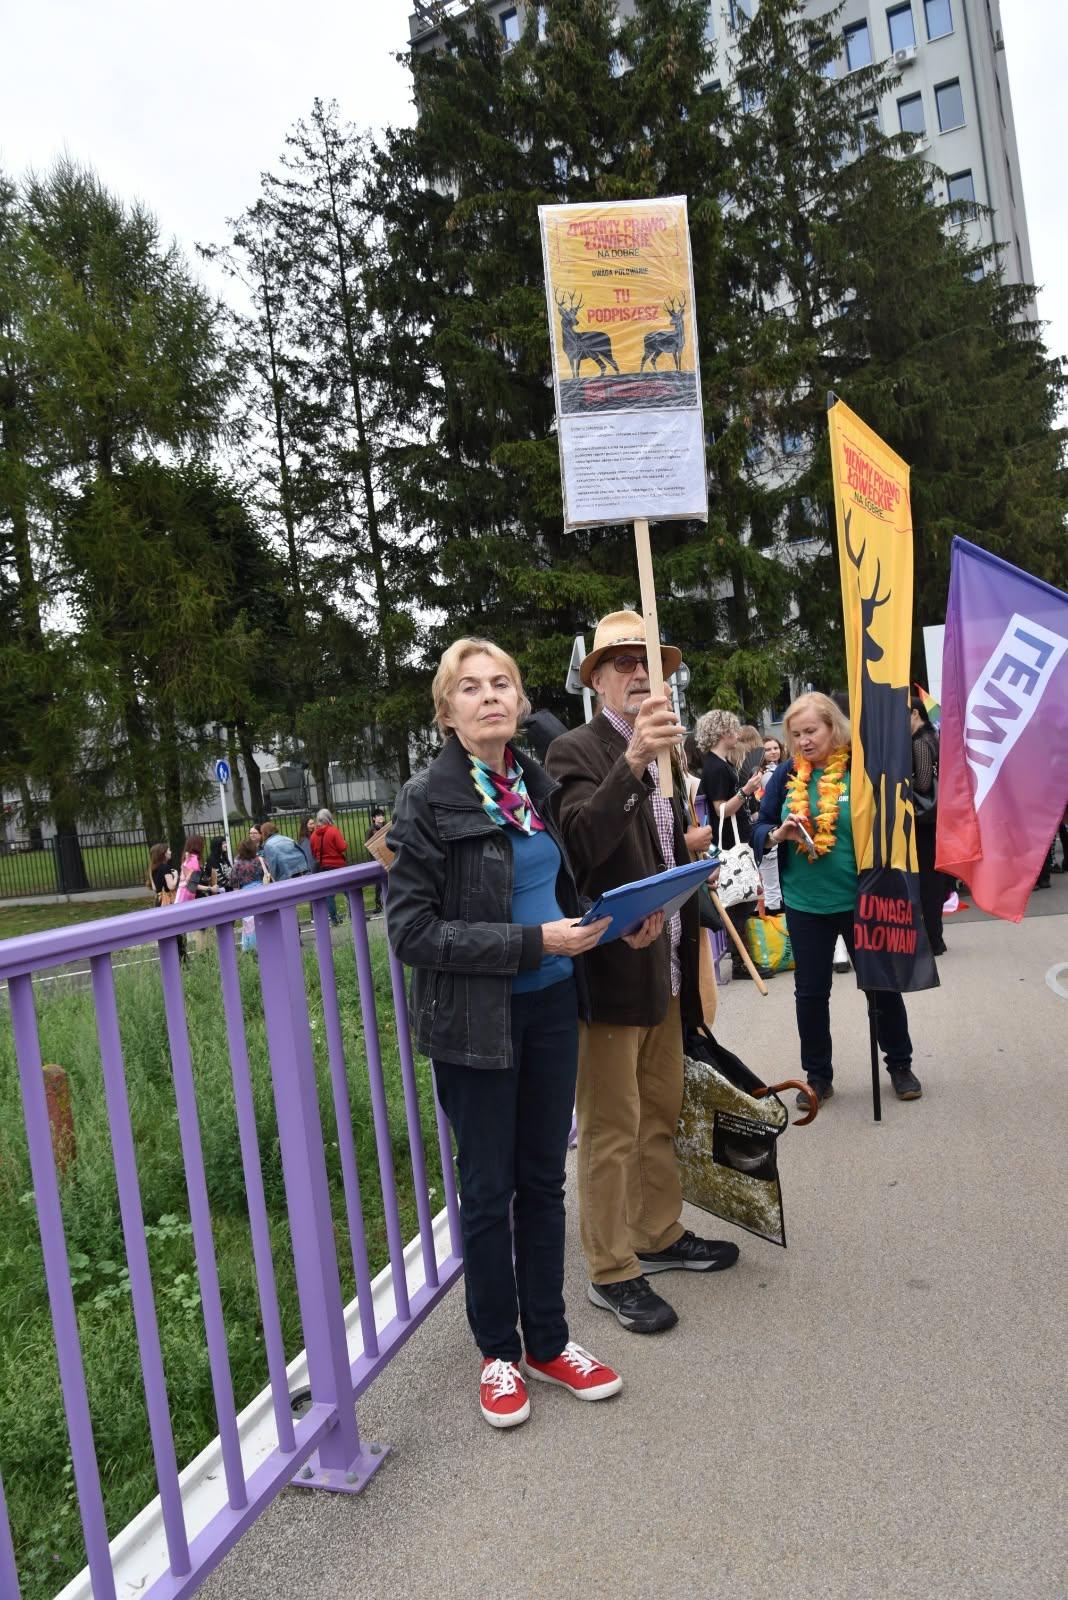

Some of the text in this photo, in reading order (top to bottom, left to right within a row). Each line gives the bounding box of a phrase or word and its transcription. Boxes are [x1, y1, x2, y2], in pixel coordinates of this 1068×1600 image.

[624, 217, 667, 233] PRAWO
[597, 248, 640, 258] NA DOBRE
[613, 288, 630, 303] TU
[587, 306, 660, 323] PODPISZESZ
[873, 470, 900, 505] PRAWO
[854, 491, 864, 505] NA
[859, 894, 913, 925] UWAGA
